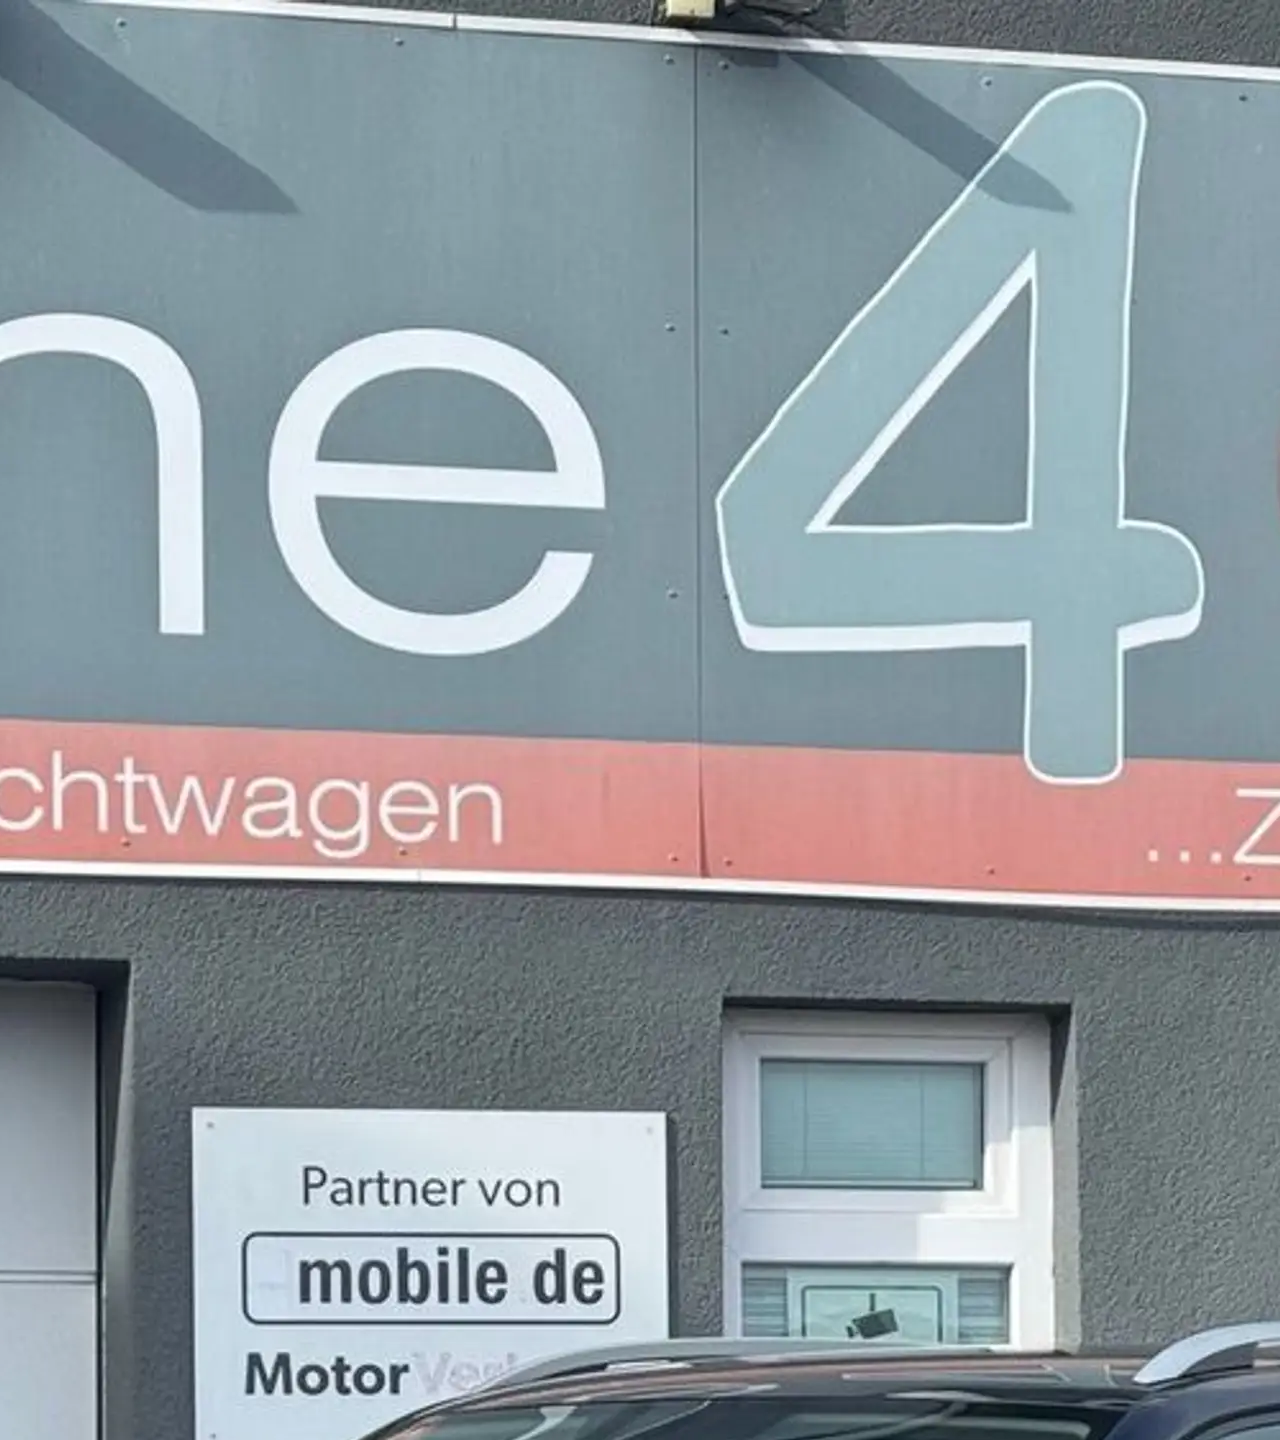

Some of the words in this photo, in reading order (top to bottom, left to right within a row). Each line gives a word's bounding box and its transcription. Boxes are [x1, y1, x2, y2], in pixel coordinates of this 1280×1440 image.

[301, 1164, 467, 1208] Partner
[477, 1177, 561, 1209] von
[298, 1245, 509, 1306] mobile
[532, 1246, 606, 1306] de
